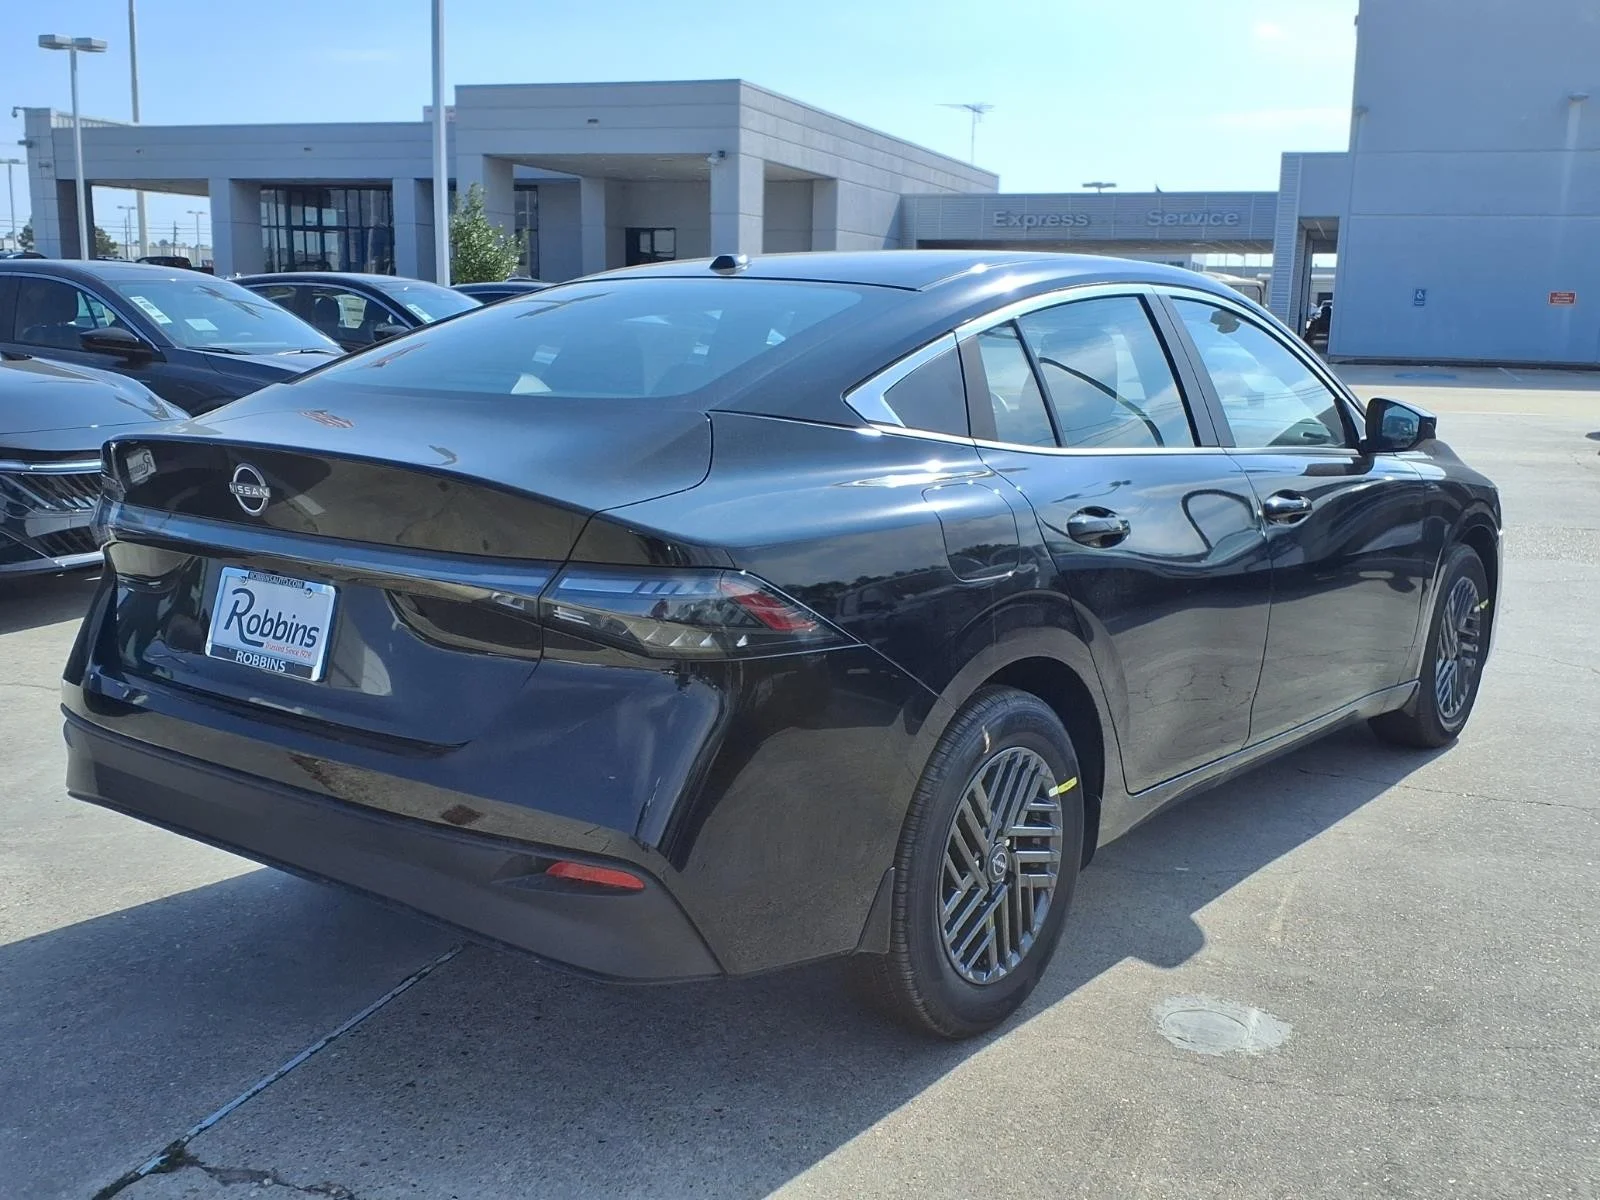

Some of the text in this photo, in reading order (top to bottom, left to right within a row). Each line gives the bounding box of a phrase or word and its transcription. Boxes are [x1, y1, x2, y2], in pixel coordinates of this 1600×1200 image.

[992, 209, 1239, 230] Express Service
[229, 483, 269, 497] NISSAN
[224, 587, 319, 648] Robbins
[236, 651, 286, 672] ROBBINS
